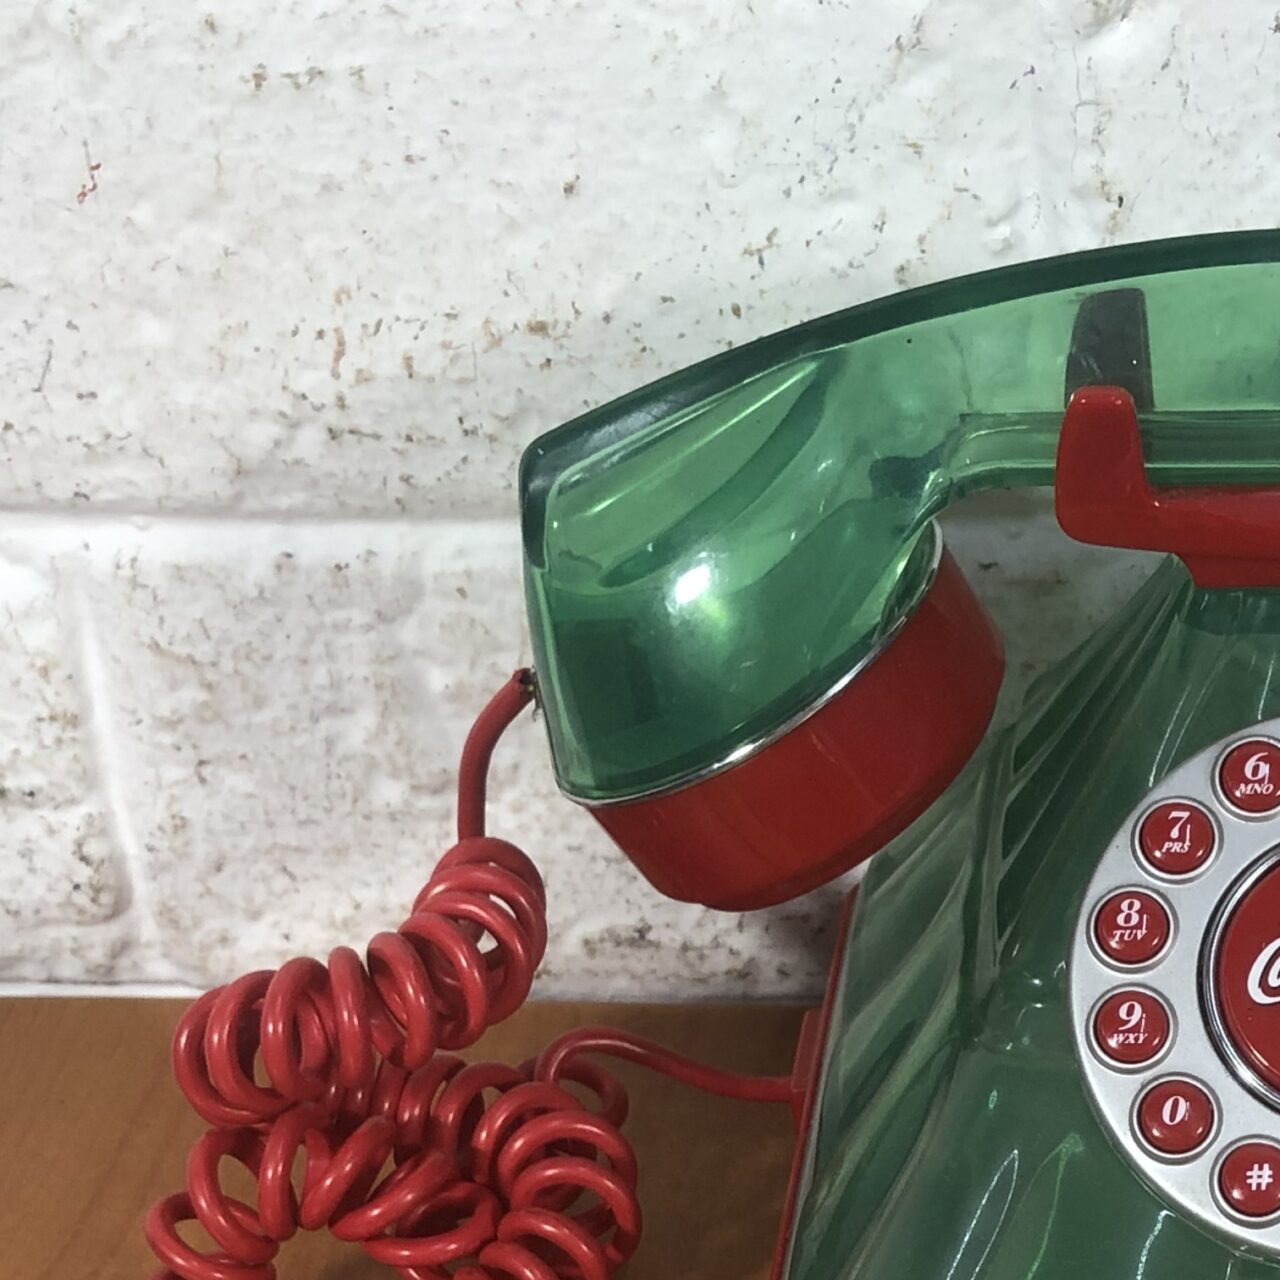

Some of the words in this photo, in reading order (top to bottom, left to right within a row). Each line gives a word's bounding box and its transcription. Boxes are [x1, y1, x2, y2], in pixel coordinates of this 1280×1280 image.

[1244, 752, 1269, 782] 6
[1237, 782, 1274, 795] MNO
[1167, 810, 1191, 839] 7
[1161, 841, 1191, 854] PRS
[1115, 898, 1142, 927] 8
[1112, 929, 1148, 943] TUV
[1117, 1000, 1143, 1031] 9
[1113, 1032, 1149, 1045] WXY
[1161, 1095, 1187, 1126] 0
[1245, 1162, 1274, 1192] #
